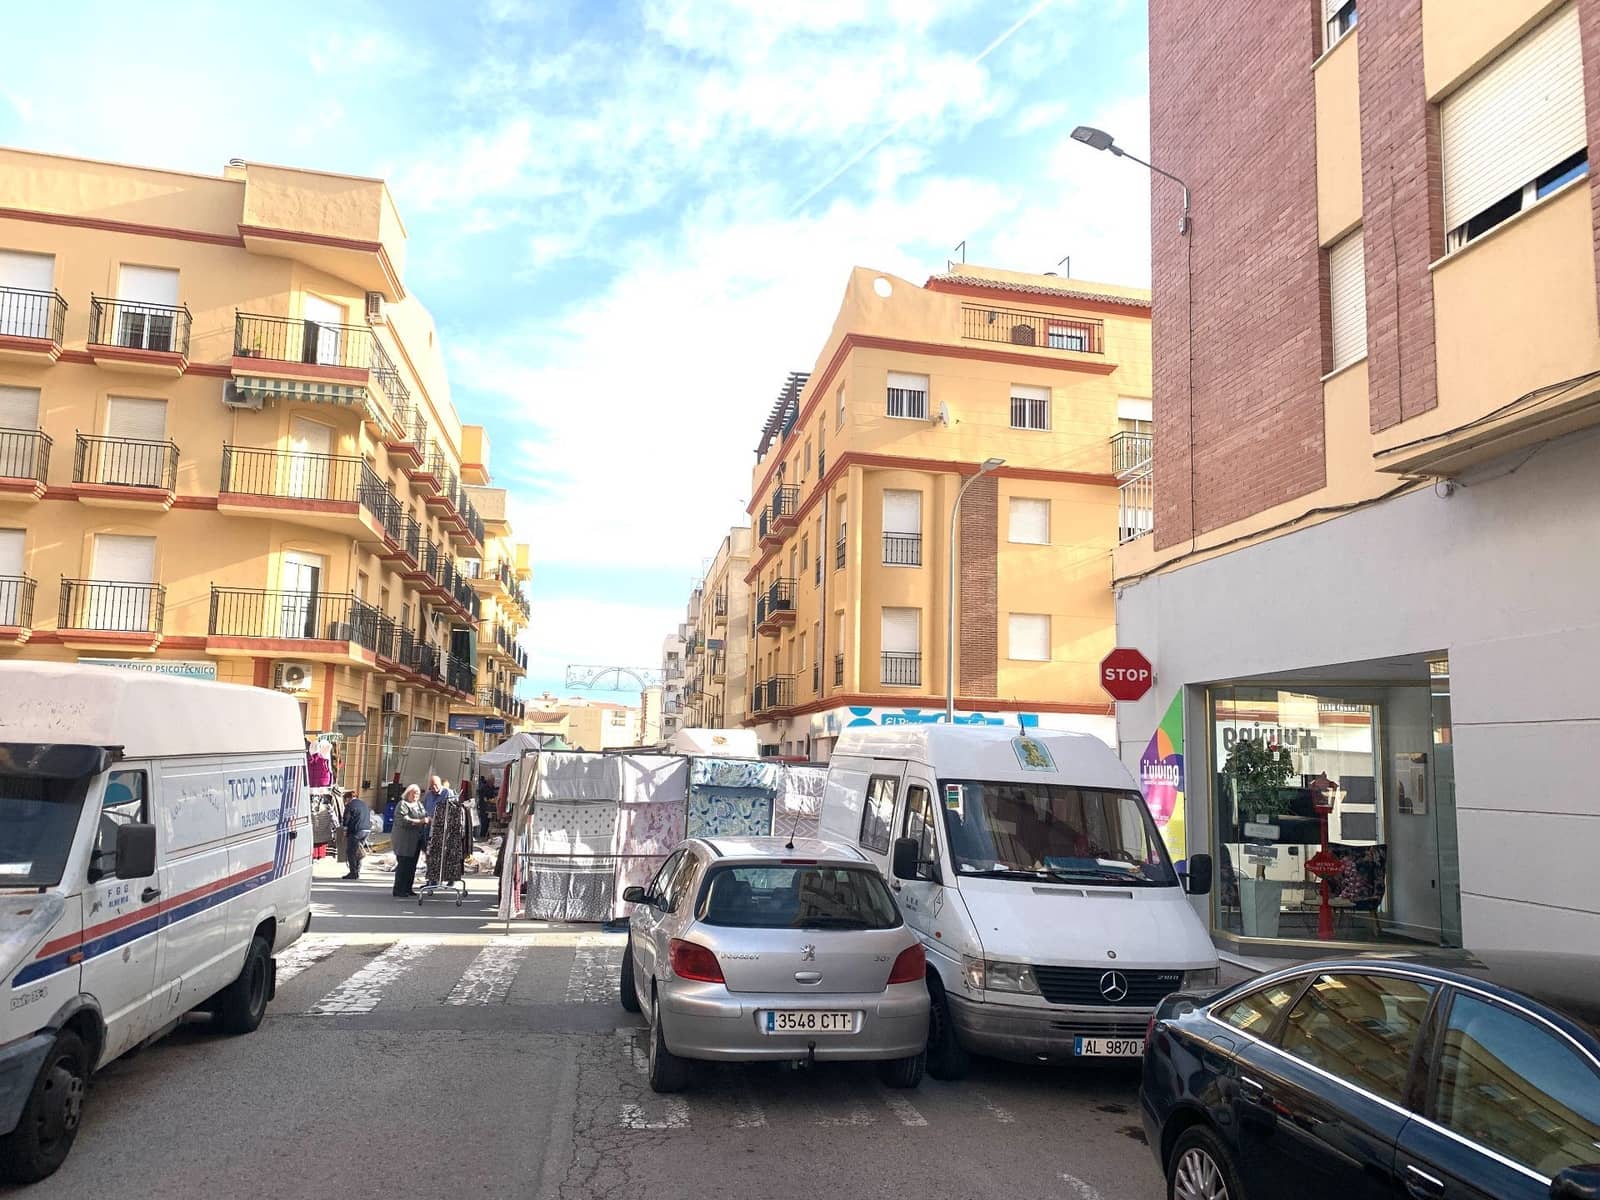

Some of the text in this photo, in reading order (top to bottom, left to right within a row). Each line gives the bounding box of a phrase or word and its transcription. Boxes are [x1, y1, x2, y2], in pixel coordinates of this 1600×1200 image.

[155, 663, 215, 675] PSICOTÉCNICO
[1105, 668, 1149, 682] STOP
[228, 777, 256, 802] TODO
[260, 776, 268, 797] A
[778, 1013, 848, 1029] 3548 CTT
[1085, 1040, 1101, 1055] AL
[1106, 1040, 1137, 1055] 9870
